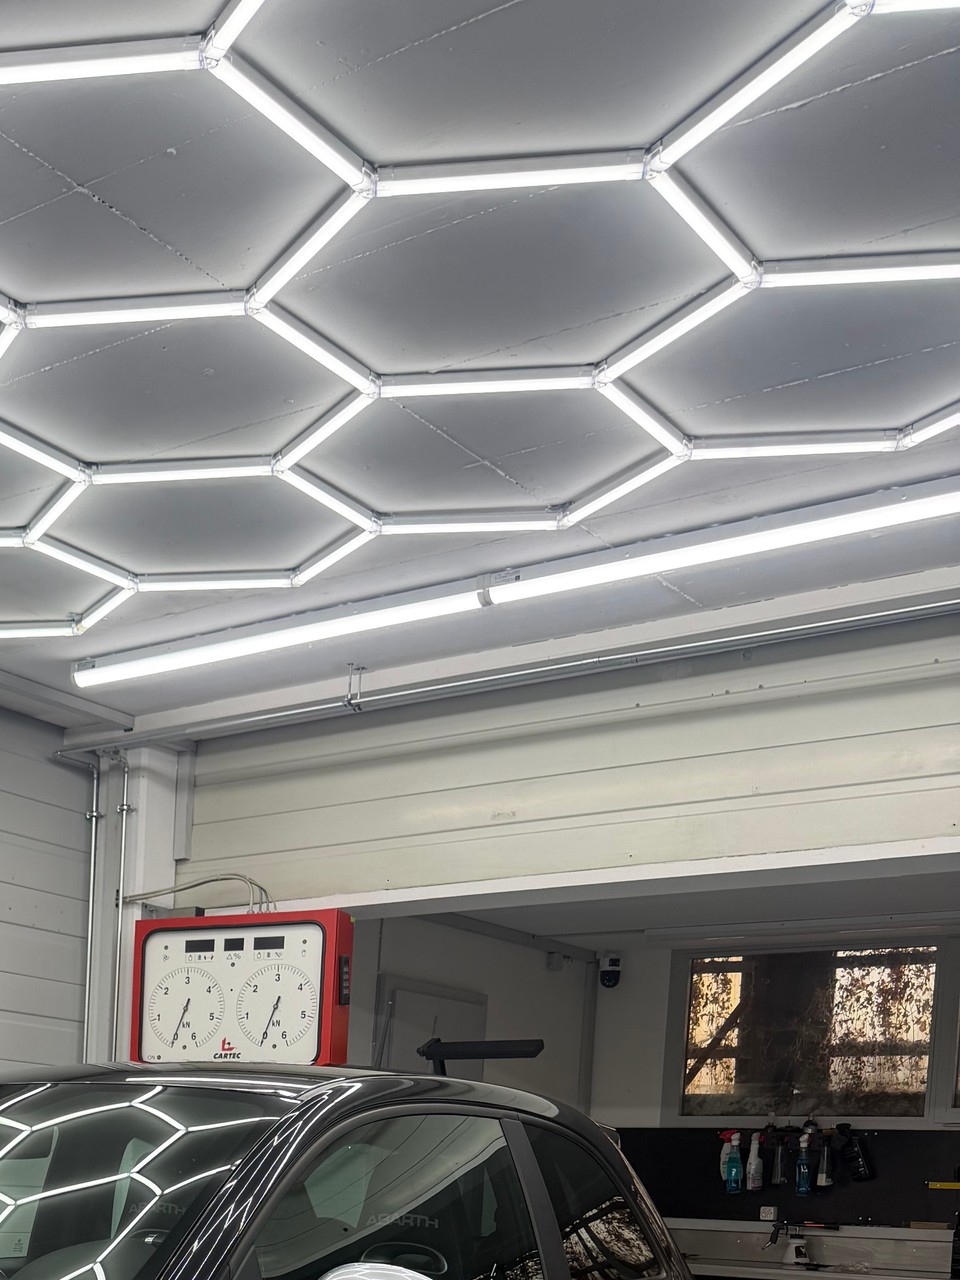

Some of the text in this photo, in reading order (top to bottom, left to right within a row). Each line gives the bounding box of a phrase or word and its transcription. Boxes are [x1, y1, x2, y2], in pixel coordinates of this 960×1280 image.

[185, 976, 190, 985] 3
[275, 973, 281, 982] 3
[163, 987, 169, 995] 2
[206, 985, 212, 994] 4
[252, 985, 258, 993] 2
[297, 983, 303, 991] 4
[209, 1012, 215, 1021] 5
[300, 1011, 306, 1019] 5
[272, 1019, 281, 1027] kN
[191, 1032, 197, 1040] 6
[281, 1031, 287, 1039] 6
[213, 1052, 242, 1060] CARTEC
